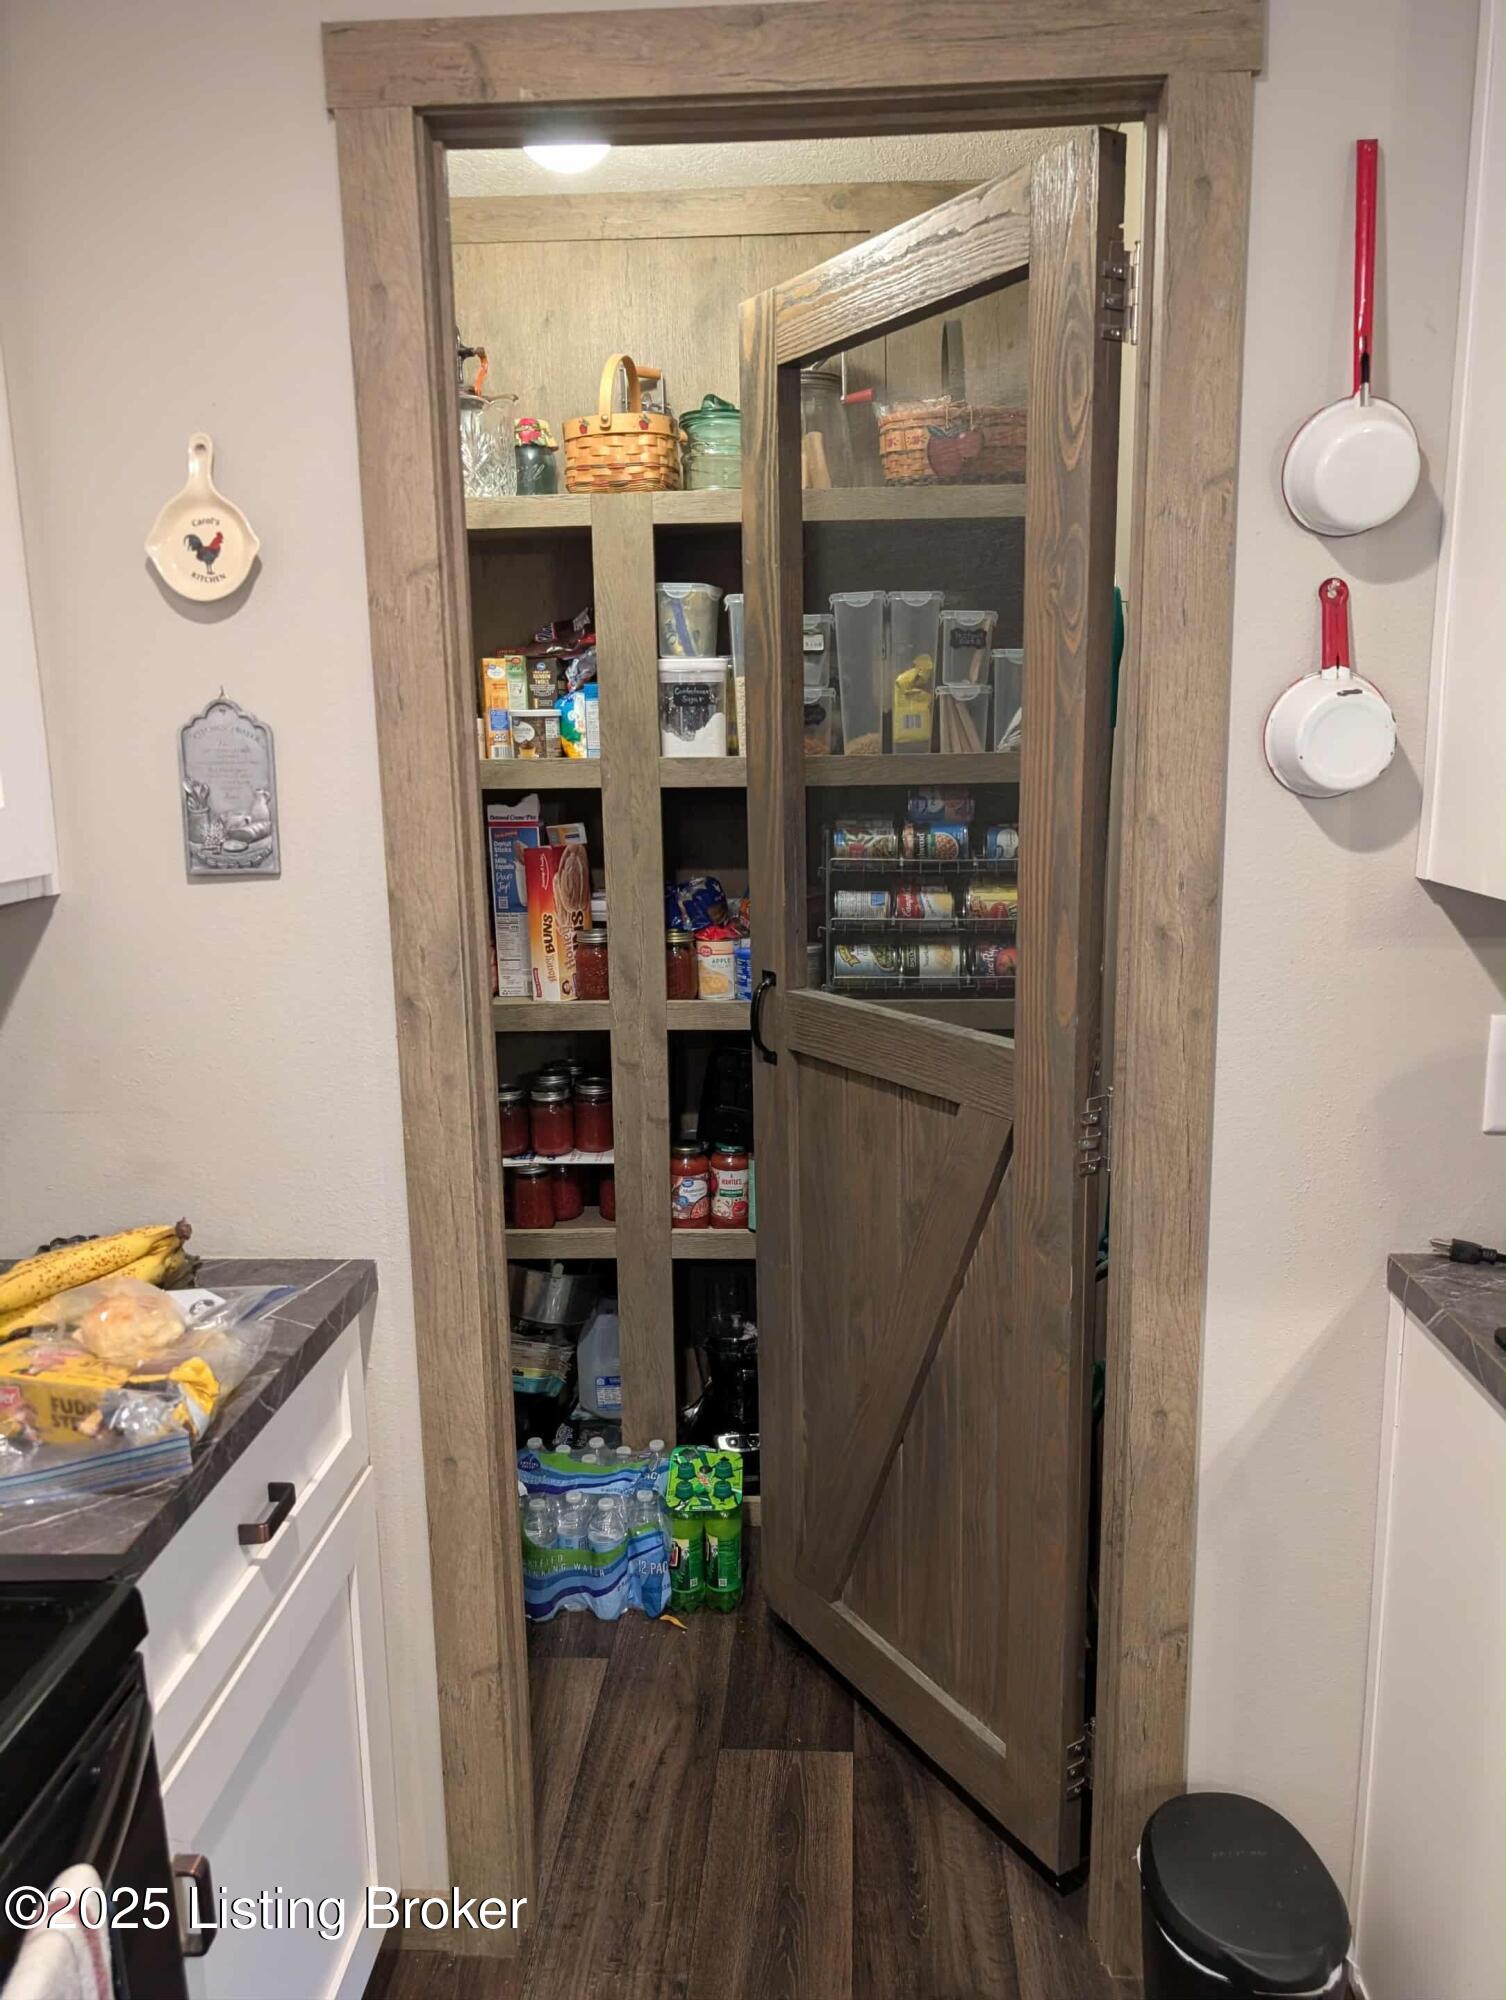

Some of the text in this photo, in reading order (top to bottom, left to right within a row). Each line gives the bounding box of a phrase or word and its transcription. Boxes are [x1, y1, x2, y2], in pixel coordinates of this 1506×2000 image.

[191, 571, 226, 584] KITCHEN
[542, 913, 556, 955] BUNS
[637, 1560, 669, 1575] 12 PAC
